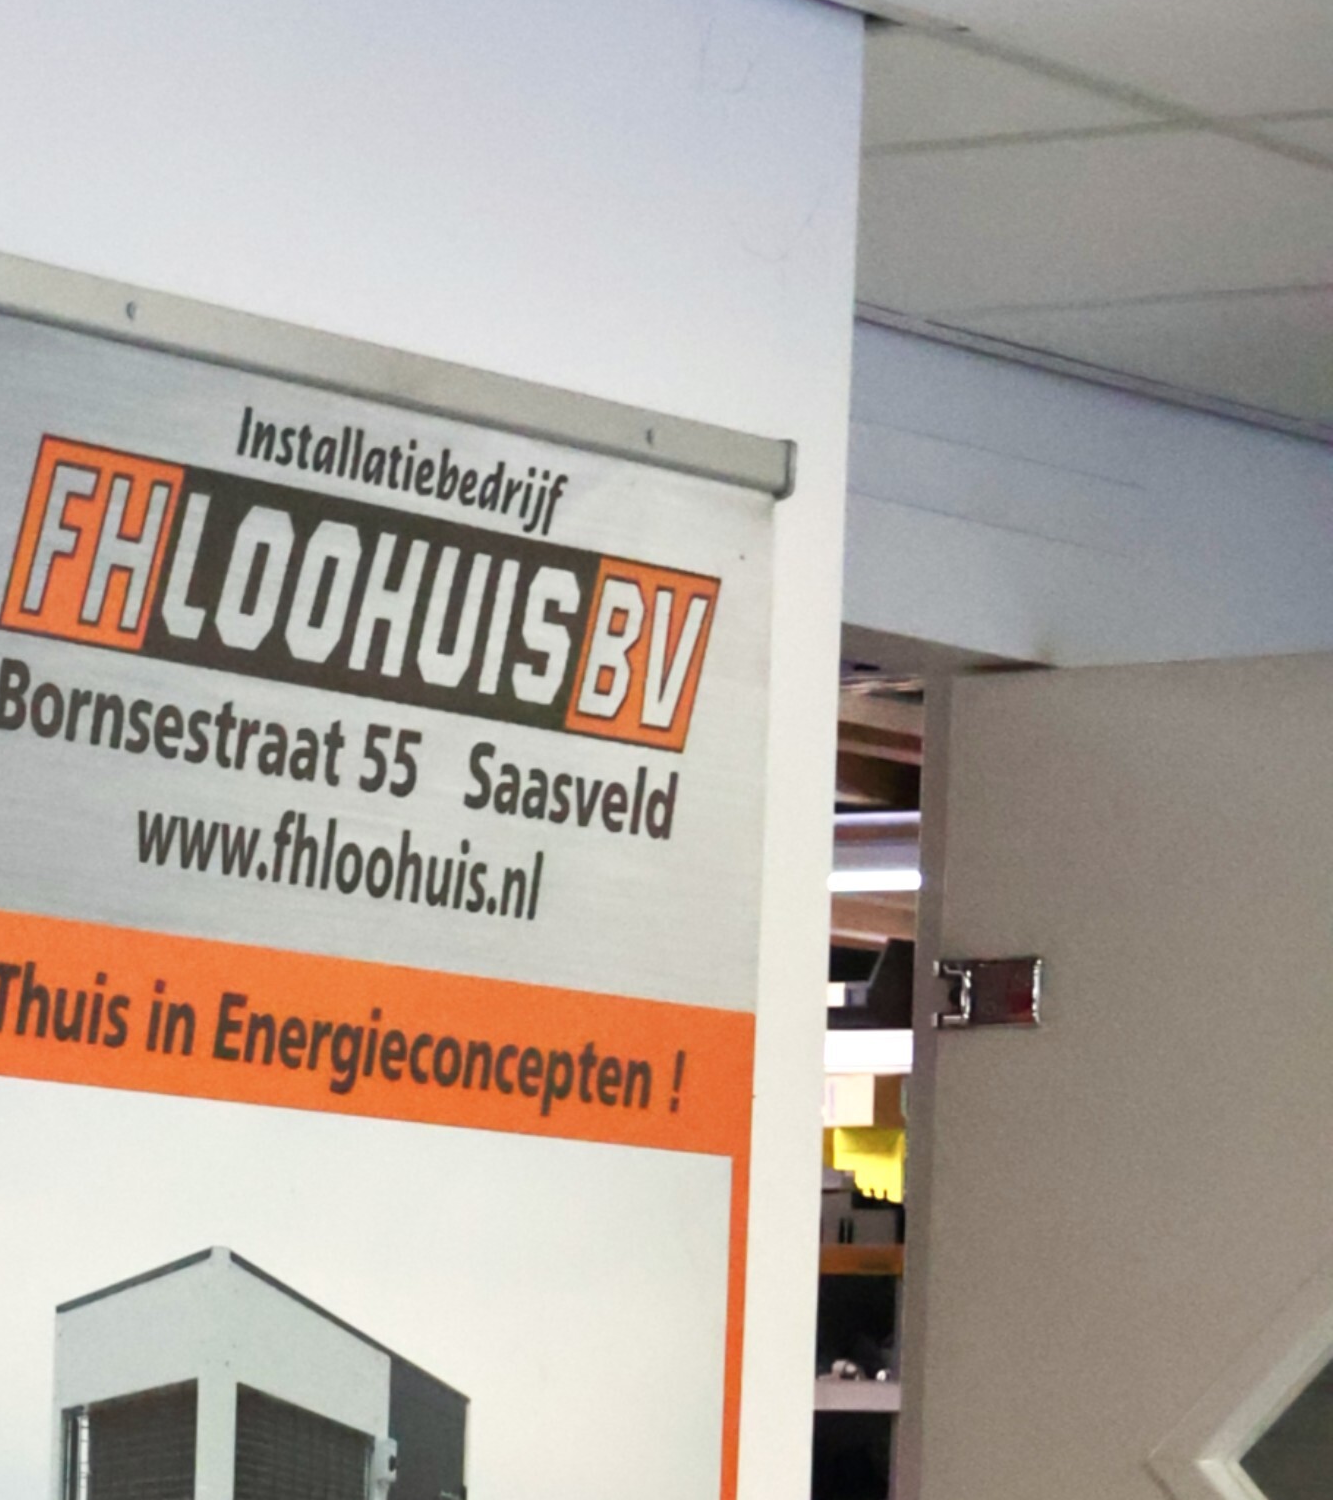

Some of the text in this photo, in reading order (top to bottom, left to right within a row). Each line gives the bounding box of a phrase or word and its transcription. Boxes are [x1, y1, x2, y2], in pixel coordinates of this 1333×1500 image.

[237, 407, 568, 536] Installatiebedrijf
[160, 495, 581, 706] LOOHUIS
[576, 576, 707, 730] BV
[358, 724, 423, 798] 55
[463, 742, 679, 842] Saasveld
[137, 810, 545, 922] www.fhloohuis.nl
[146, 981, 196, 1058] in
[212, 992, 653, 1118] Energieconcepten
[669, 1051, 688, 1113] !
